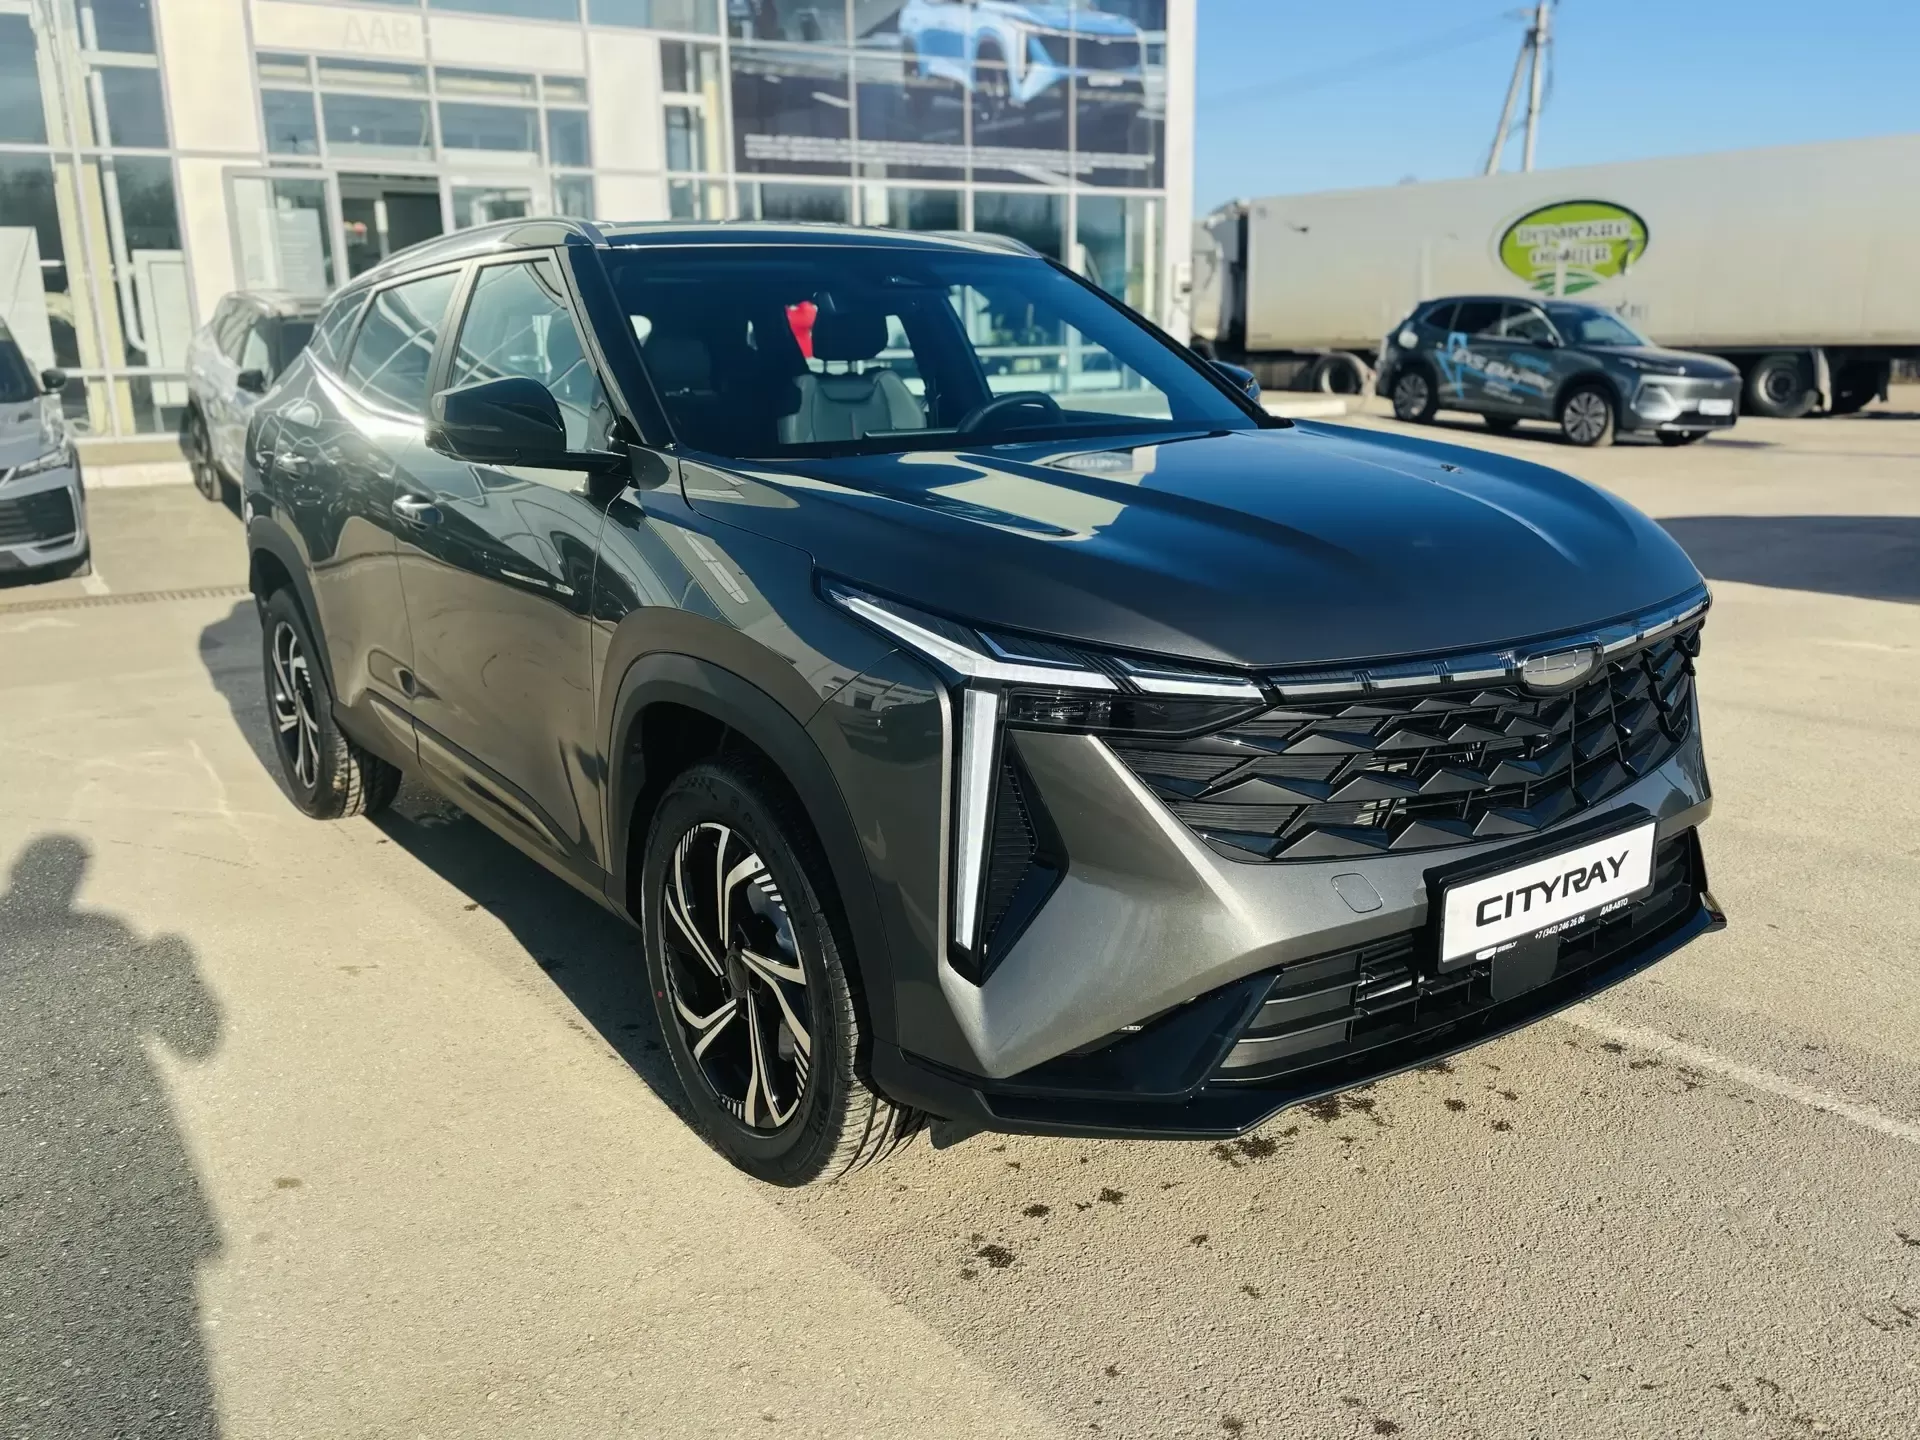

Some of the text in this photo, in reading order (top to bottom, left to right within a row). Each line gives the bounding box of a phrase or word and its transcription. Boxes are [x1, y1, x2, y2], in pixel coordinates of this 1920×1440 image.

[1475, 849, 1630, 927] CITYRAY
[1600, 897, 1629, 917] ДАВ-АВТО
[1534, 930, 1543, 940] +7
[1543, 924, 1559, 939] (342)
